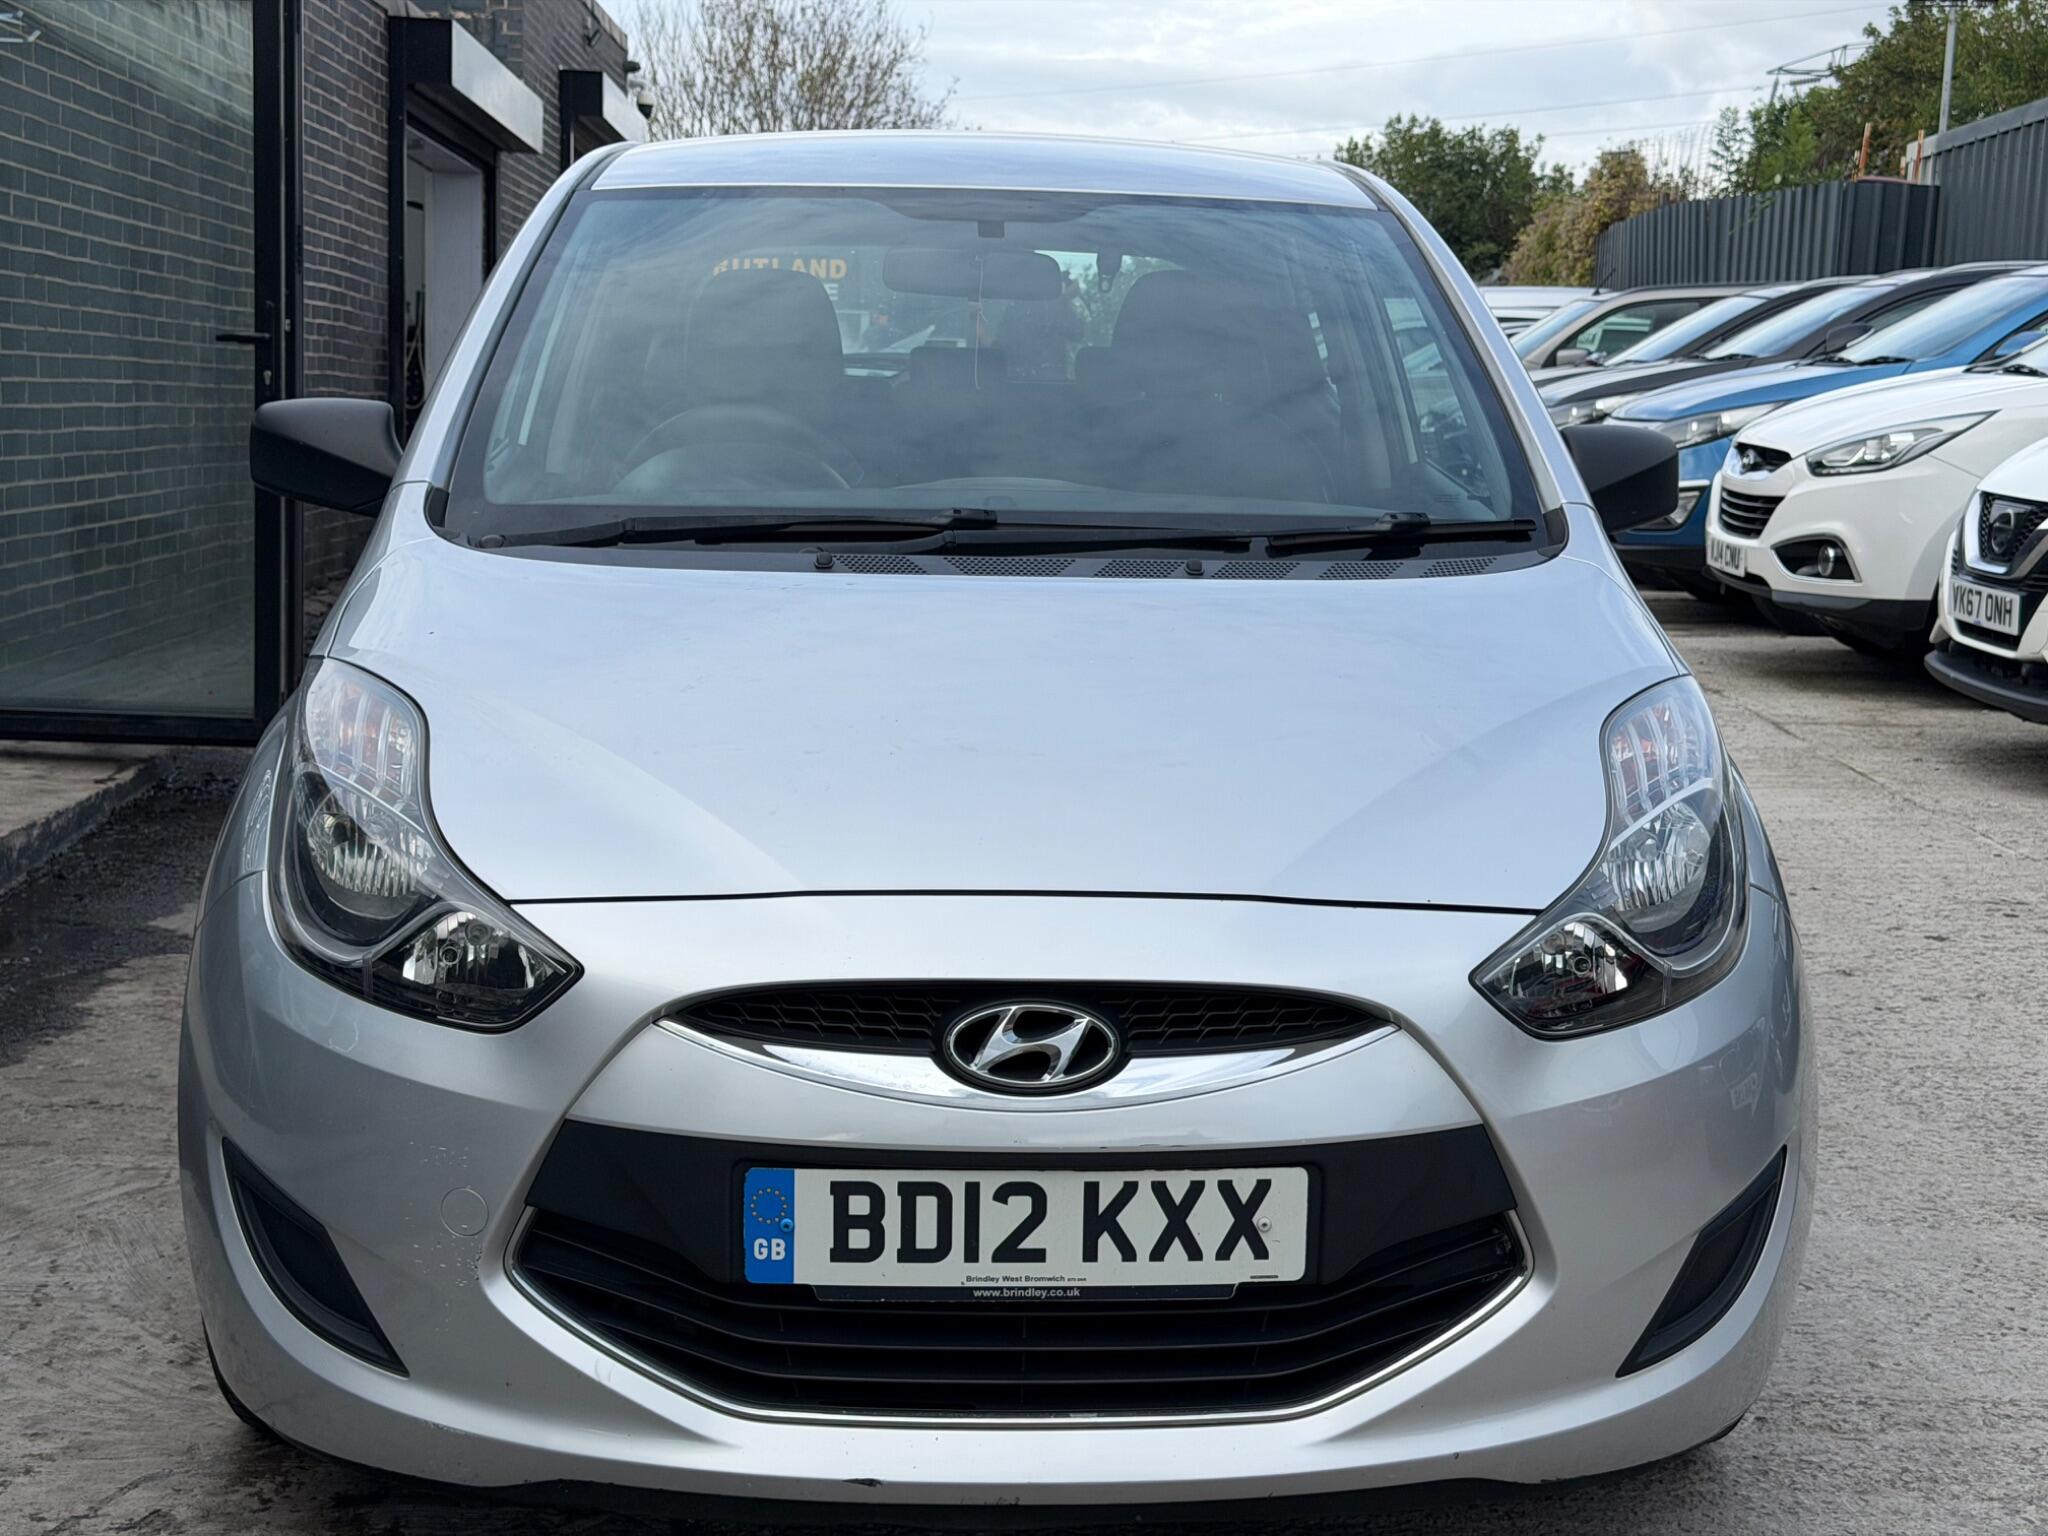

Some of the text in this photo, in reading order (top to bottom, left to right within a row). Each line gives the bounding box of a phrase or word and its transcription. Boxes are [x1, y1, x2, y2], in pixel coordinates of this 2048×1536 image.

[1952, 583, 2013, 628] VK67 ONH
[829, 1179, 1273, 1264] BD12 KXX
[753, 1238, 786, 1261] GB
[966, 1275, 1000, 1283] Brindley
[1001, 1275, 1023, 1283] West
[973, 1287, 1080, 1299] www.brindley.co.uk
